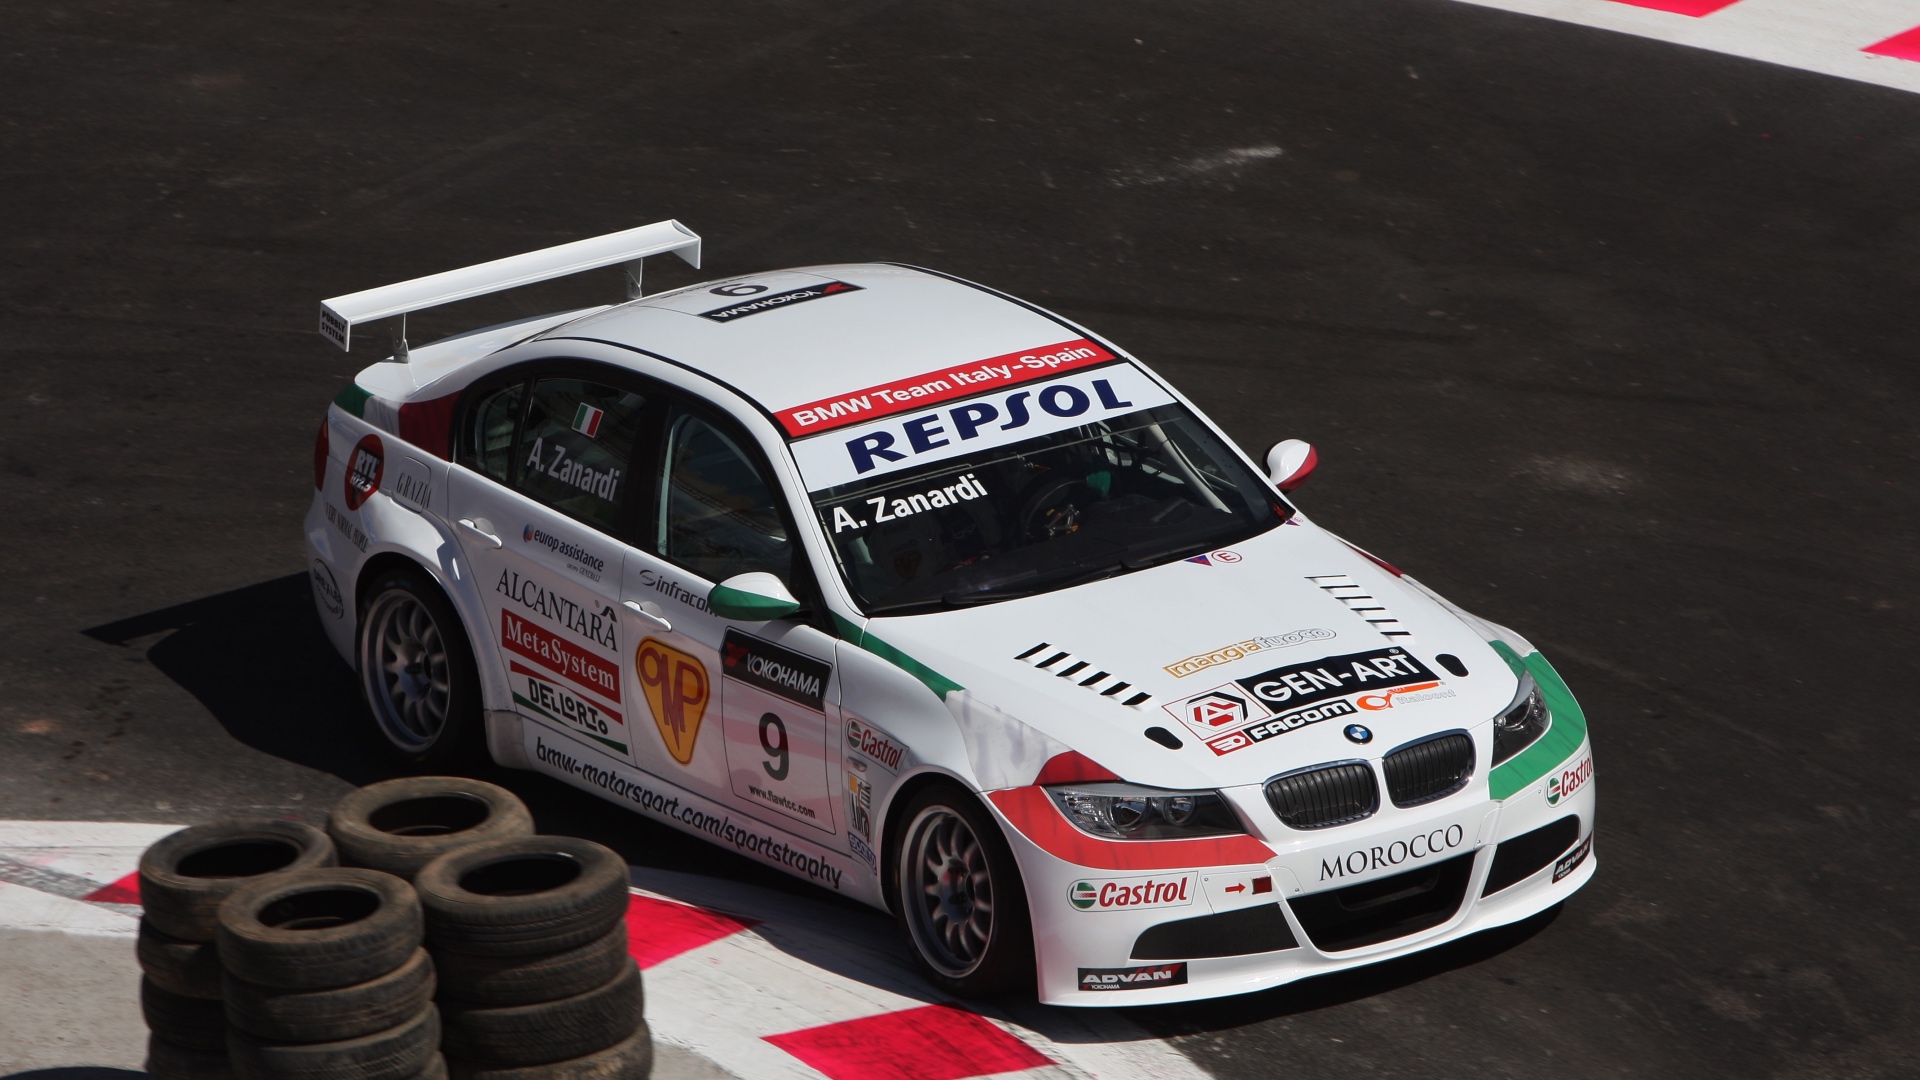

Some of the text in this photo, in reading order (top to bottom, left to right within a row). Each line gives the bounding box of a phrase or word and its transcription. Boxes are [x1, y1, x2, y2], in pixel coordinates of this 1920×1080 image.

[711, 289, 823, 318] YOKOHAMA
[321, 321, 345, 345] SYSTEM
[791, 346, 1097, 427] BMW Team Italy-Spain
[845, 379, 1133, 475] REPSOL
[354, 448, 381, 480] RTL
[526, 436, 620, 502] A. Zanardi
[833, 473, 988, 533] A. Zanardi
[534, 529, 604, 573] europ assistance
[496, 567, 618, 653] ALCANTARA
[506, 614, 615, 692] MetaSystem
[1170, 627, 1331, 675] mangiafuoco
[746, 652, 820, 698] YOKOHAMA
[1253, 654, 1420, 702] GEN-ART
[1250, 701, 1352, 740] FACOM
[758, 712, 790, 782] 9
[861, 729, 904, 771] Castrol
[1561, 750, 1593, 797] Castrol
[536, 737, 842, 890] bmw-motorsport.com/sportstrophy
[748, 784, 816, 819] www.fiawtcc.com
[1319, 824, 1464, 882] MOROCCO
[1099, 876, 1188, 908] Castrol
[1082, 970, 1172, 984] ADVAN
